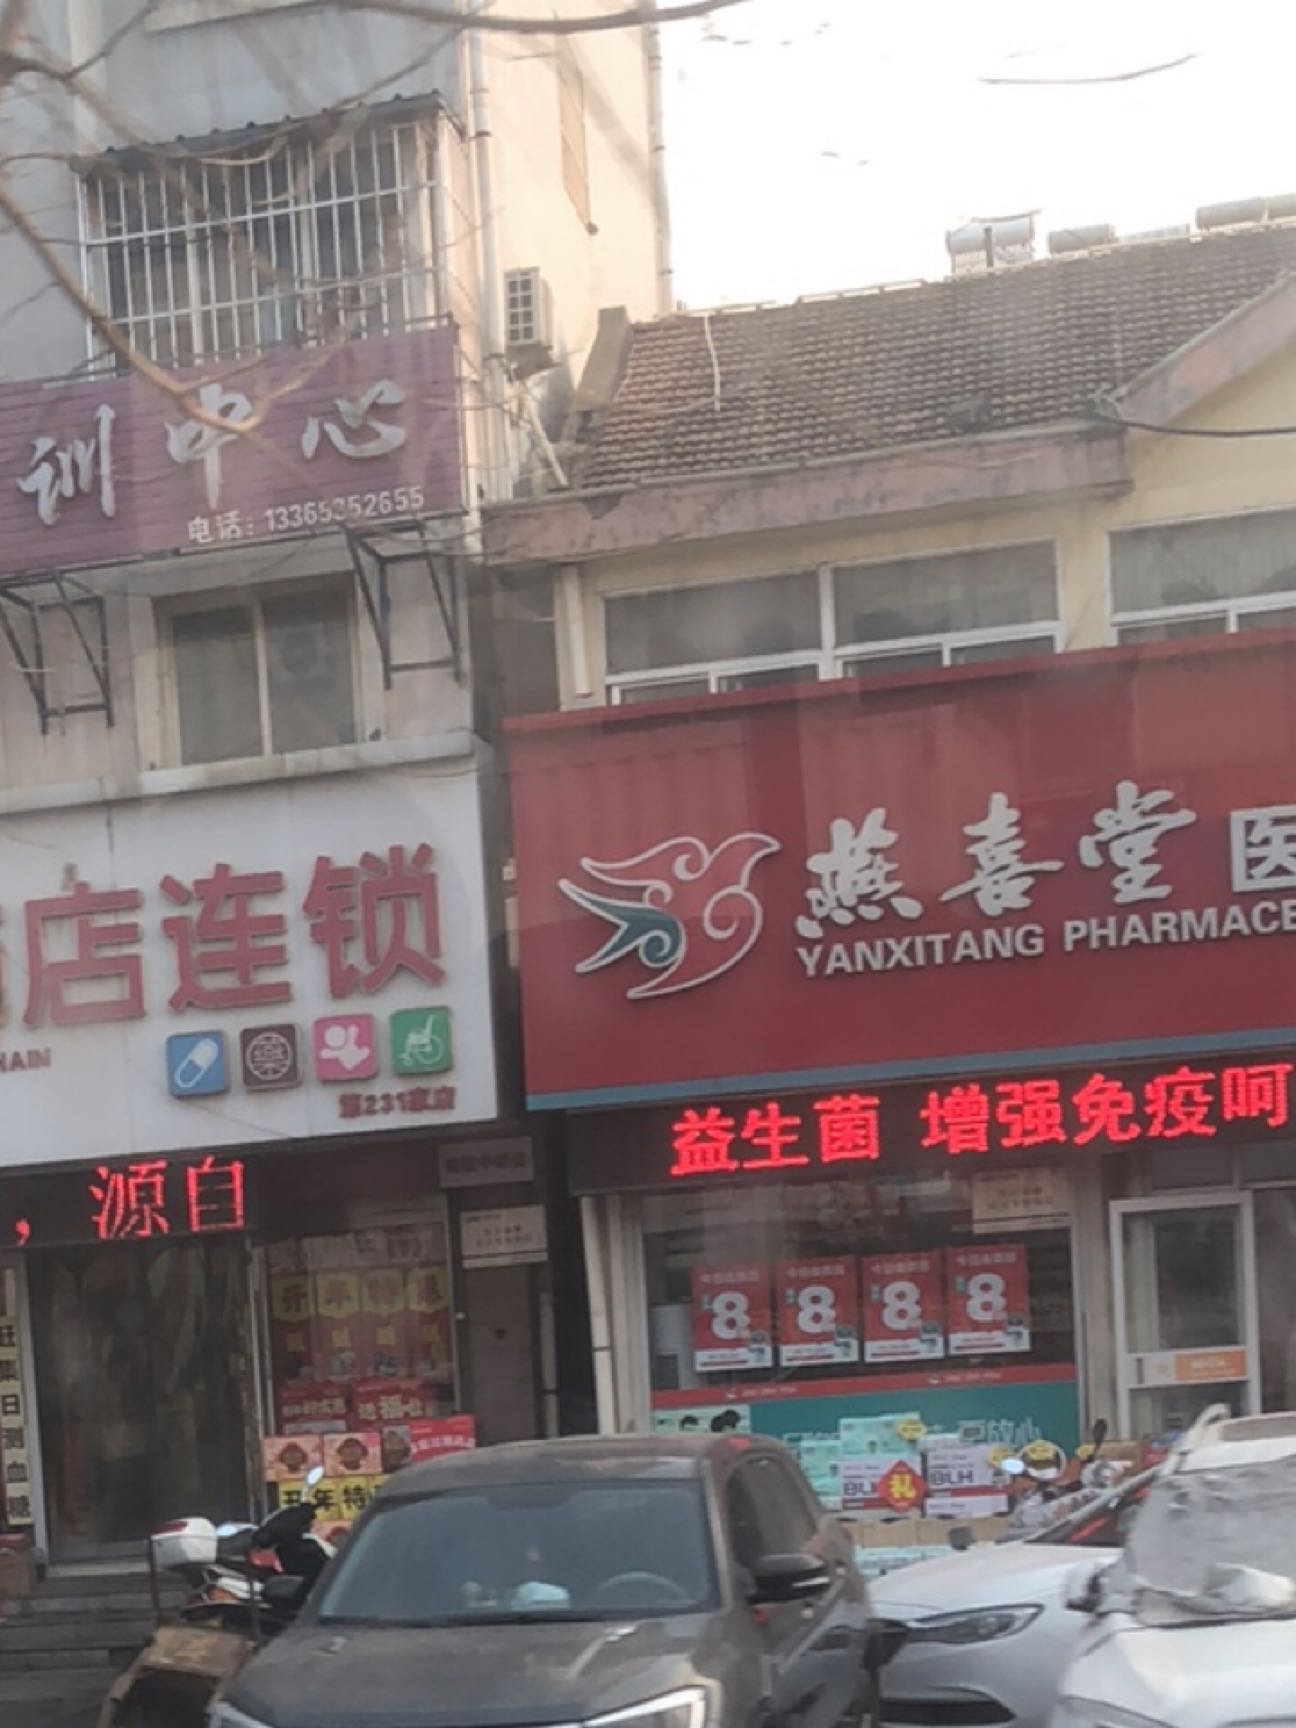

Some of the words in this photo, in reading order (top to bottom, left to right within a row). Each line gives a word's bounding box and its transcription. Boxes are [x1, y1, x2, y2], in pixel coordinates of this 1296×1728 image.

[797, 925, 1045, 977] YANXITANG
[670, 1094, 880, 1178] 益生菌
[920, 1062, 1293, 1156] 增强免疫呵
[712, 1291, 750, 1340] 8
[797, 1285, 836, 1333] 8
[882, 1280, 921, 1331] 8
[966, 1272, 1006, 1323] 8
